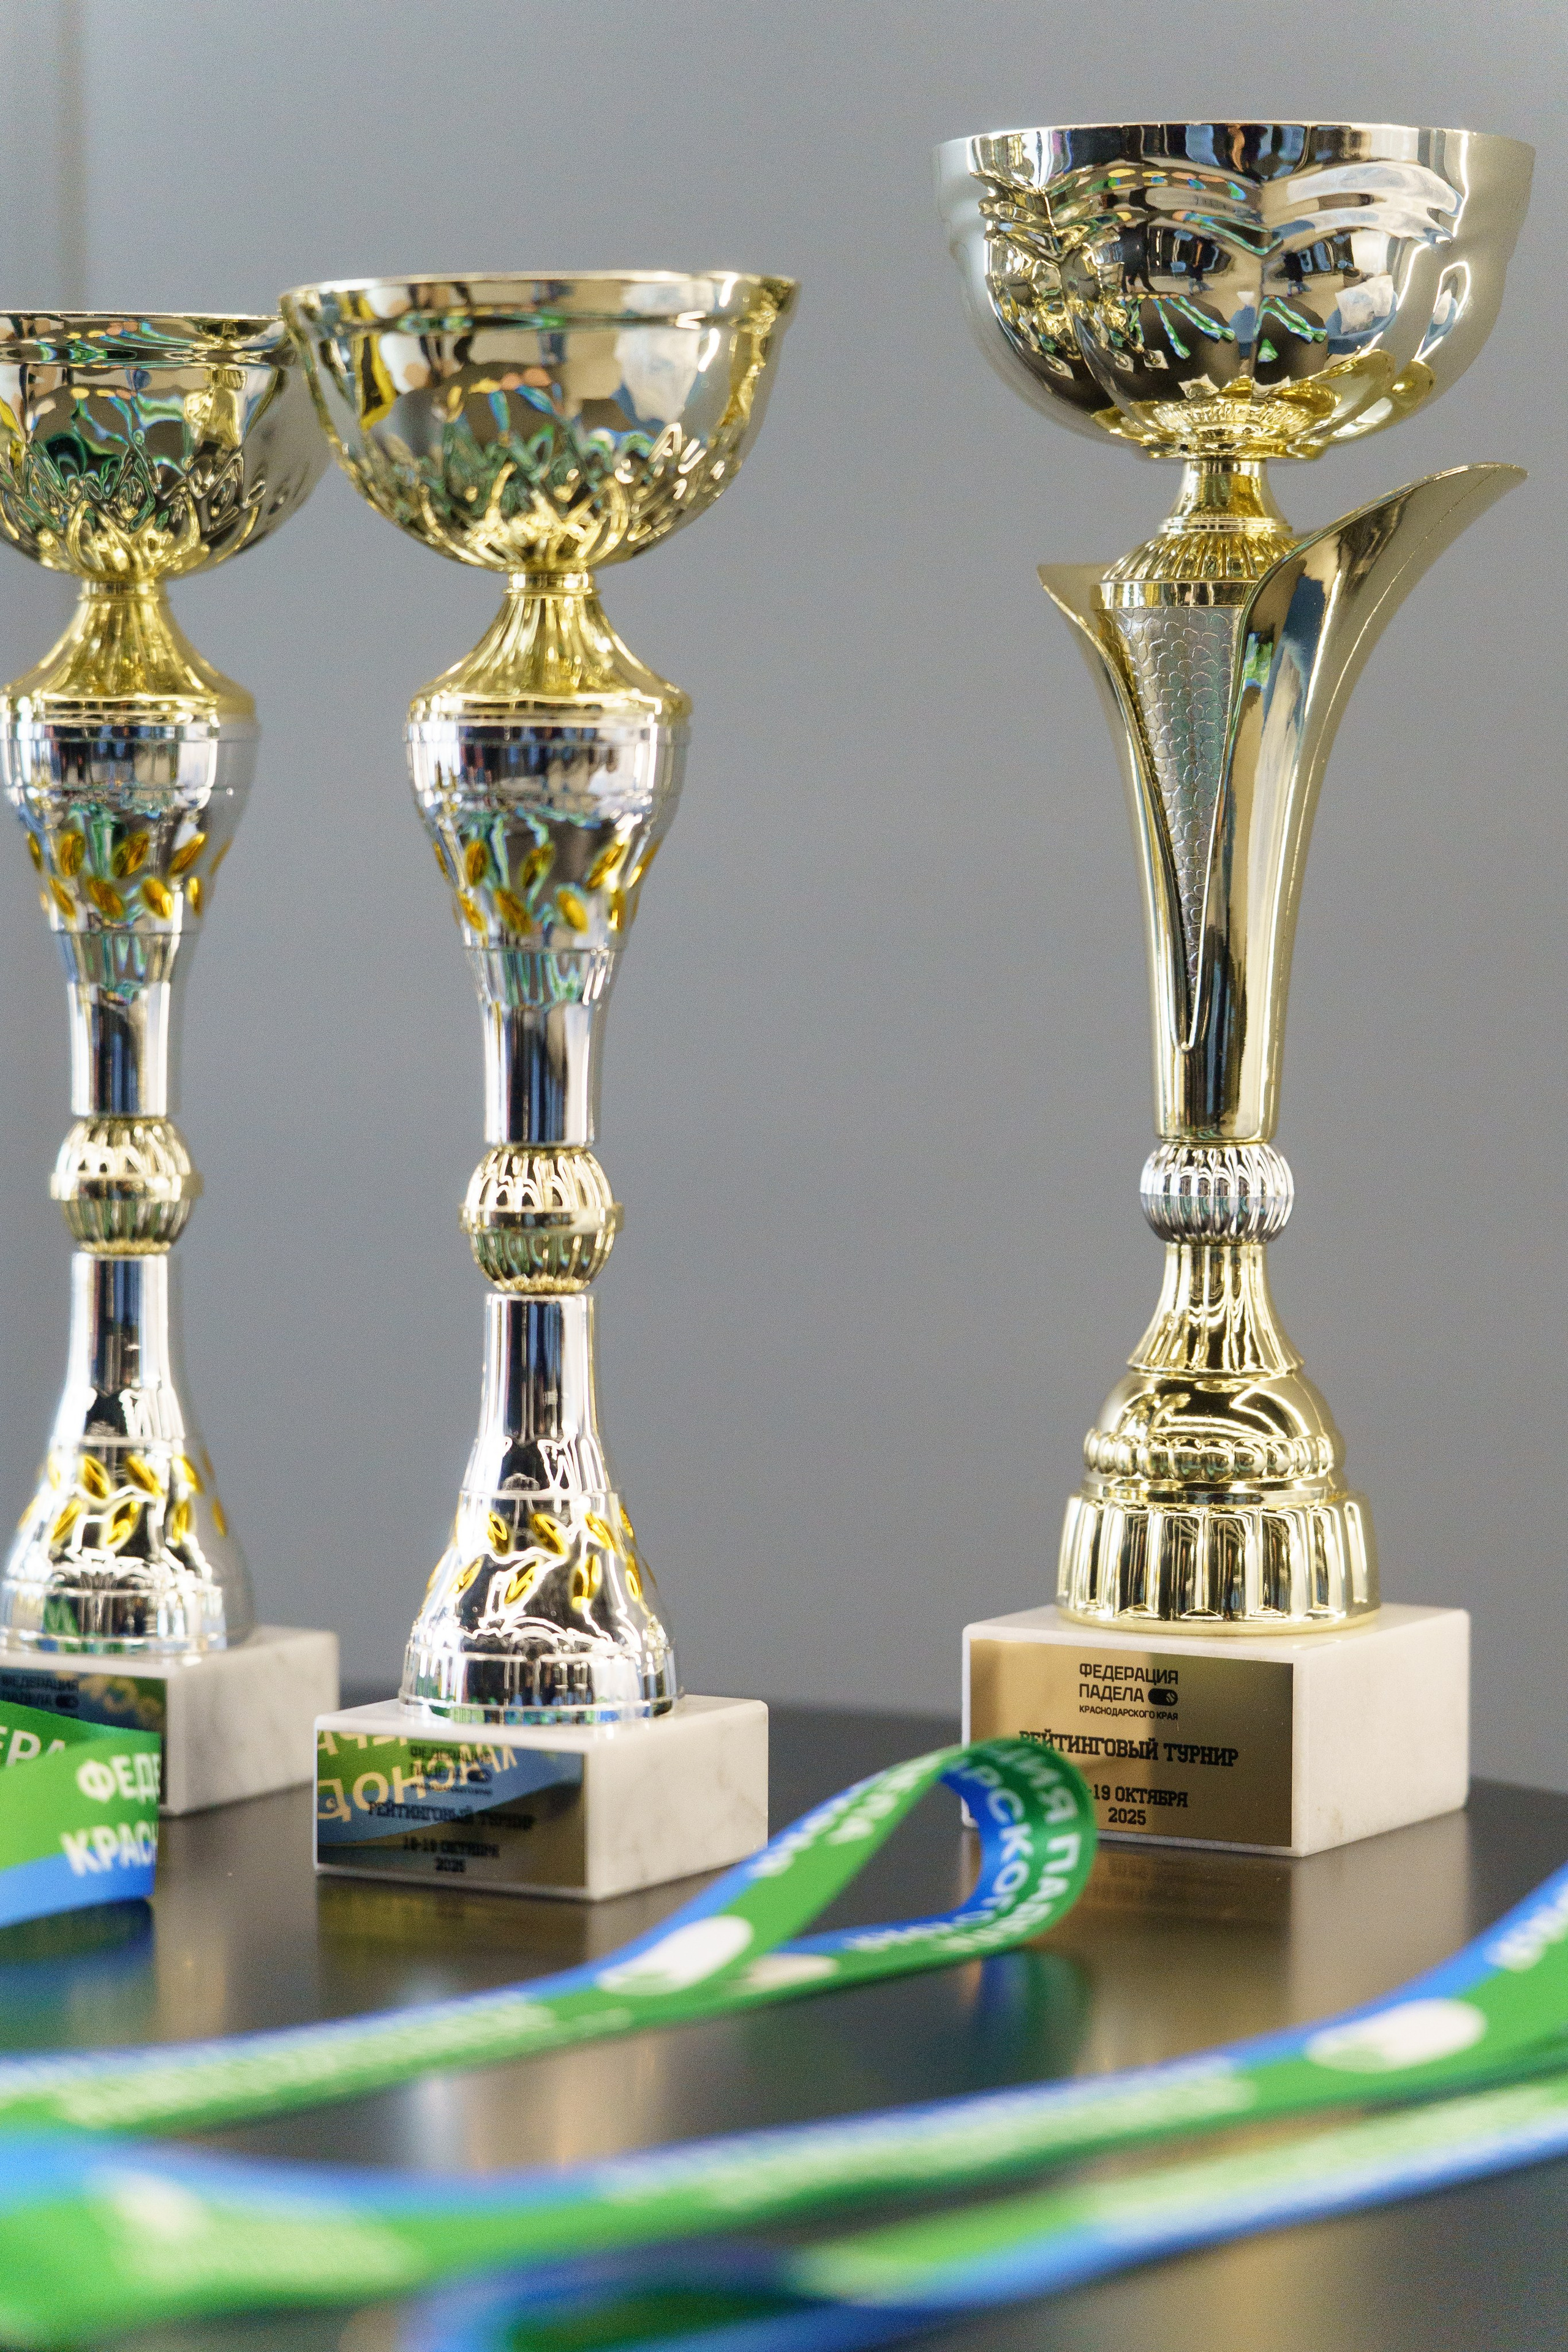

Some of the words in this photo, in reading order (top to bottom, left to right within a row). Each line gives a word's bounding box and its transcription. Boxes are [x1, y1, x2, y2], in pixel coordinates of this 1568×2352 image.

[1079, 1663, 1178, 1686] ФЕДЕРАЦИЯ
[1079, 1683, 1144, 1703] ПАДЕЛА
[1079, 1705, 1155, 1719] КРАСНОДАРСКОГО
[1156, 1712, 1178, 1721] КРАЯ
[1019, 1728, 1158, 1761] РЕЙТИНГОВЫЙ
[1164, 1743, 1238, 1767] ТУРНИР
[1115, 1785, 1188, 1807] ОКТЯБРЯ
[1107, 1806, 1147, 1826] 2025
